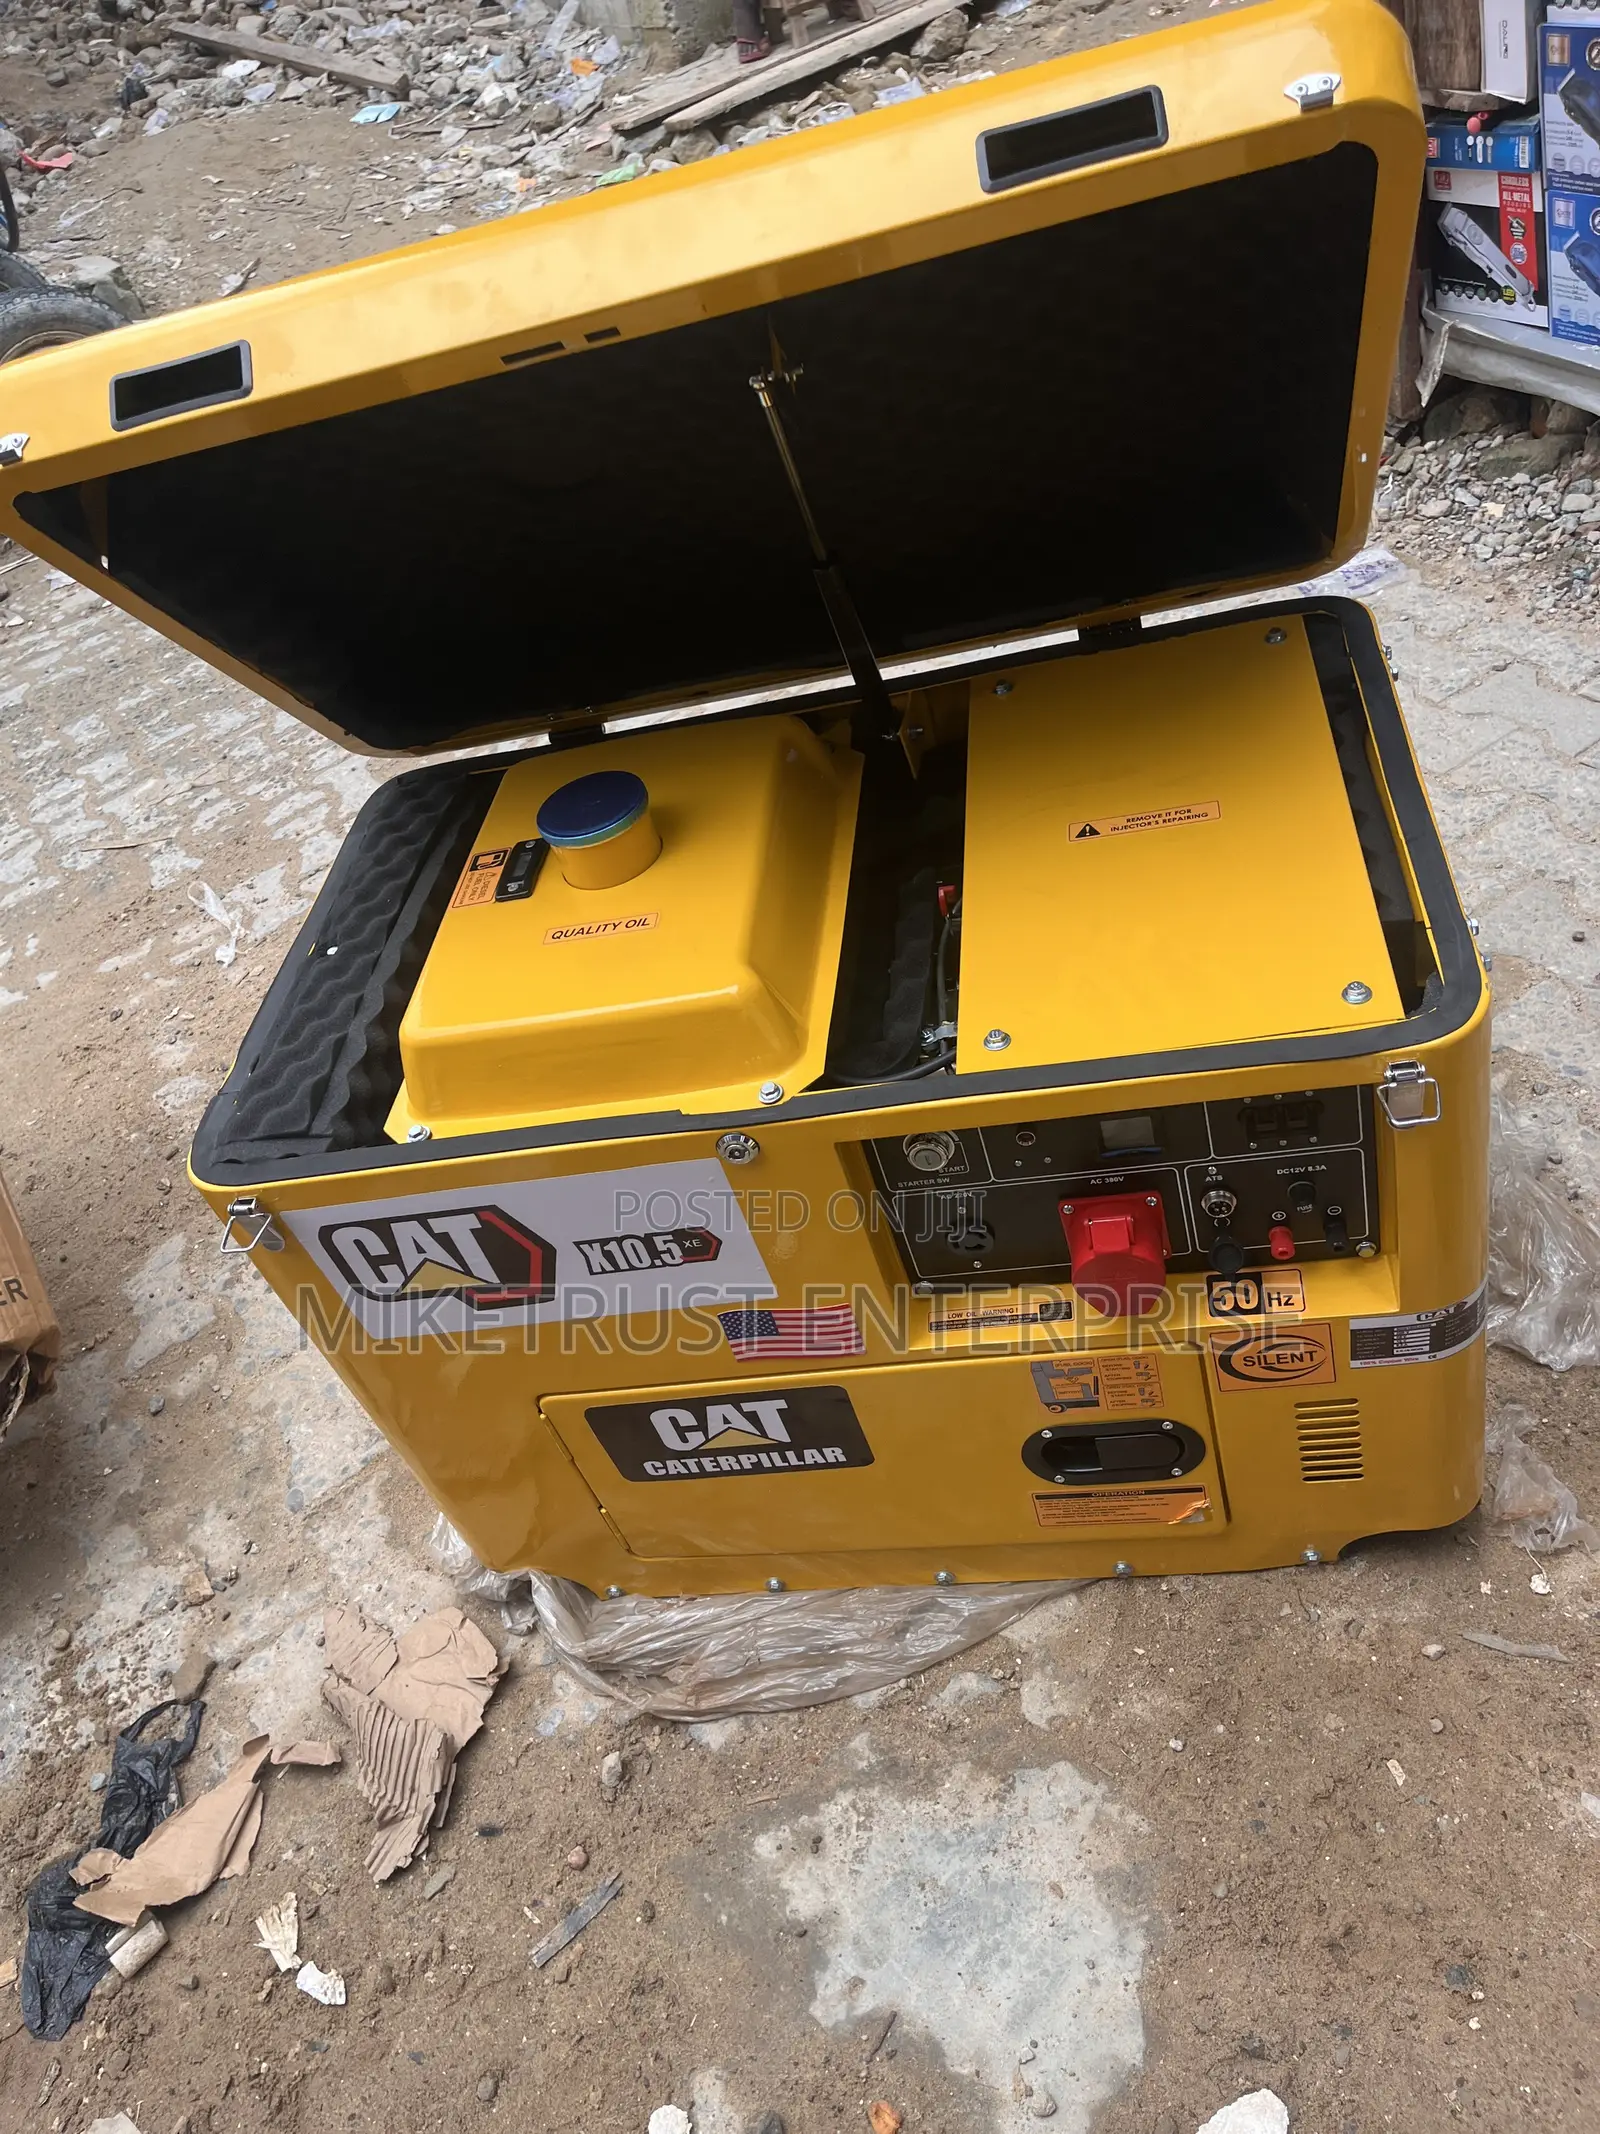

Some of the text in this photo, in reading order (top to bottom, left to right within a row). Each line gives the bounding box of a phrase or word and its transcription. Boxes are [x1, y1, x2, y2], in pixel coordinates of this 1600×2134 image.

[1110, 812, 1209, 832] INJECTOR'S REPAIRING
[1126, 813, 1162, 824] REMOVE
[1174, 808, 1192, 817] FOR
[473, 872, 485, 886] FUEL
[551, 917, 650, 940] QUALITY OIL
[939, 1165, 965, 1173] START
[1276, 1166, 1306, 1175] DC12V
[897, 1179, 935, 1187] STARTER
[1297, 1203, 1313, 1212] FUSE
[331, 1213, 501, 1295] CAT
[579, 1233, 702, 1274] X10.5 XE
[0, 1278, 28, 1306] R
[1212, 1279, 1295, 1311] 50 Hz
[947, 1312, 963, 1320] LOW
[982, 1307, 1014, 1316] WARNING
[1417, 1307, 1455, 1321] CAT
[1243, 1350, 1318, 1367] SILENT
[649, 1399, 791, 1451] CAT
[643, 1446, 847, 1476] CATERPILLAR
